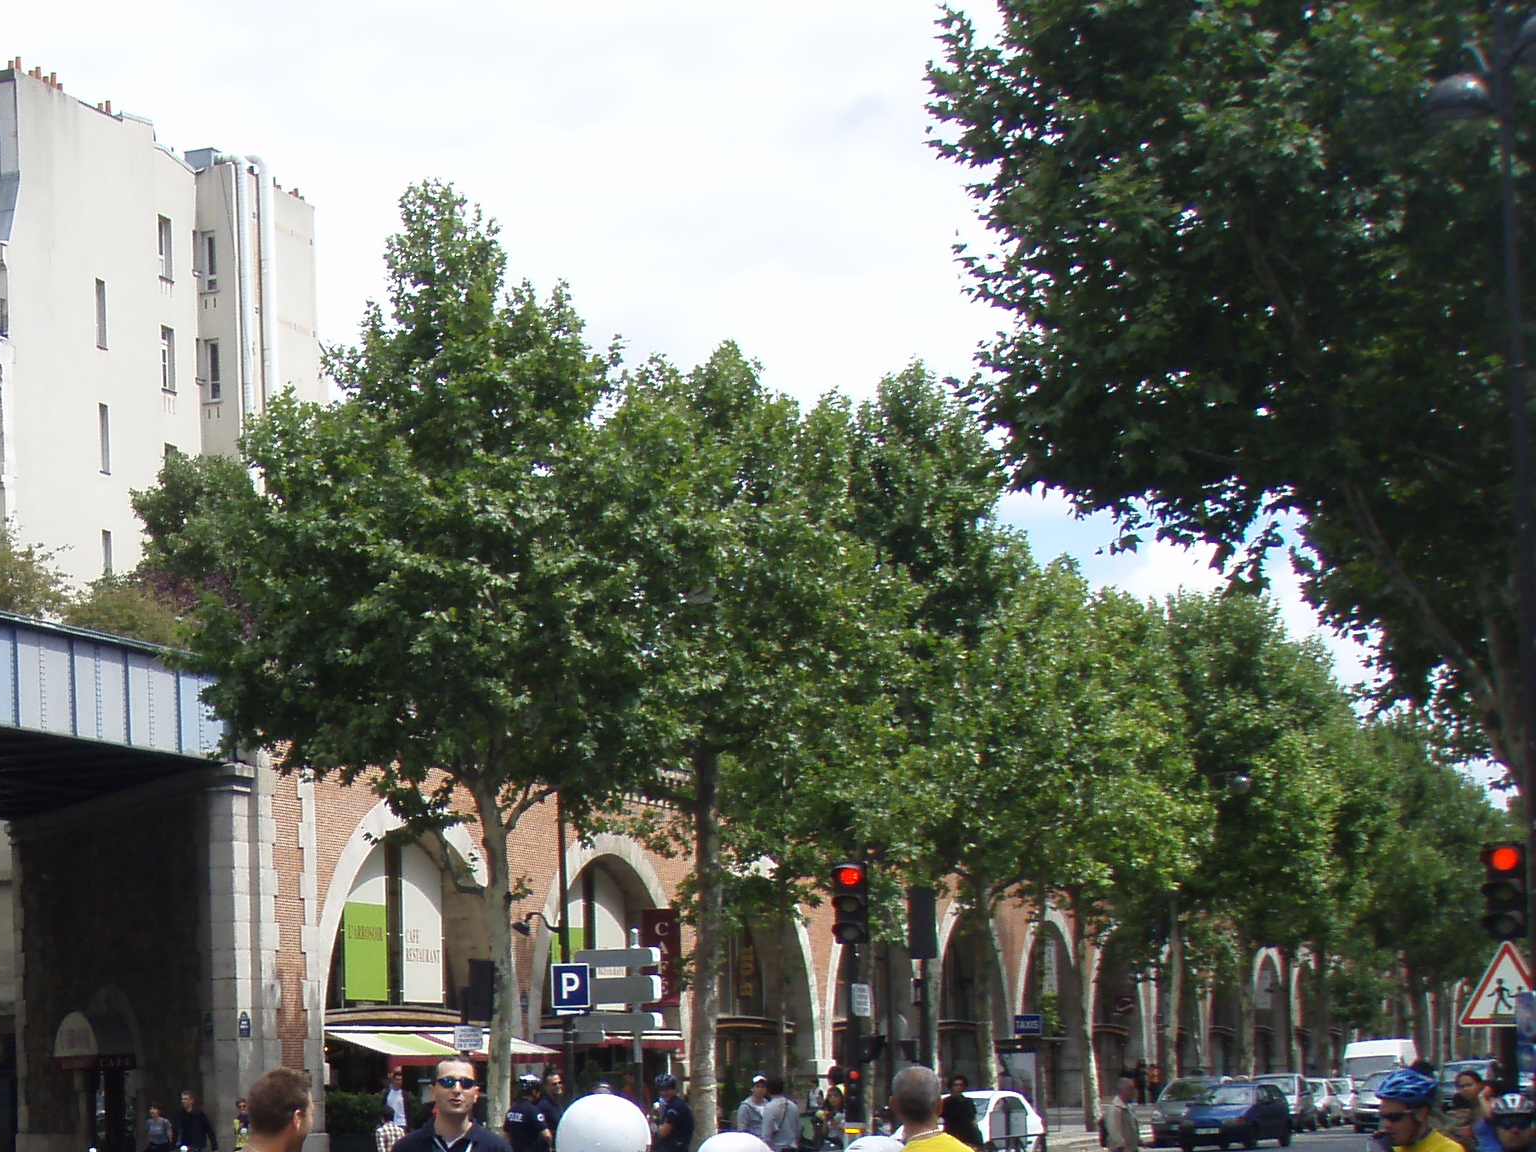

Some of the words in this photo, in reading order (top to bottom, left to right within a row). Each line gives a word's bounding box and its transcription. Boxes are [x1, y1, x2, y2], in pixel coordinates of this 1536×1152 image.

[406, 948, 440, 963] RESTAURANT
[562, 973, 580, 1000] P
[1016, 1021, 1039, 1029] TAXIS
